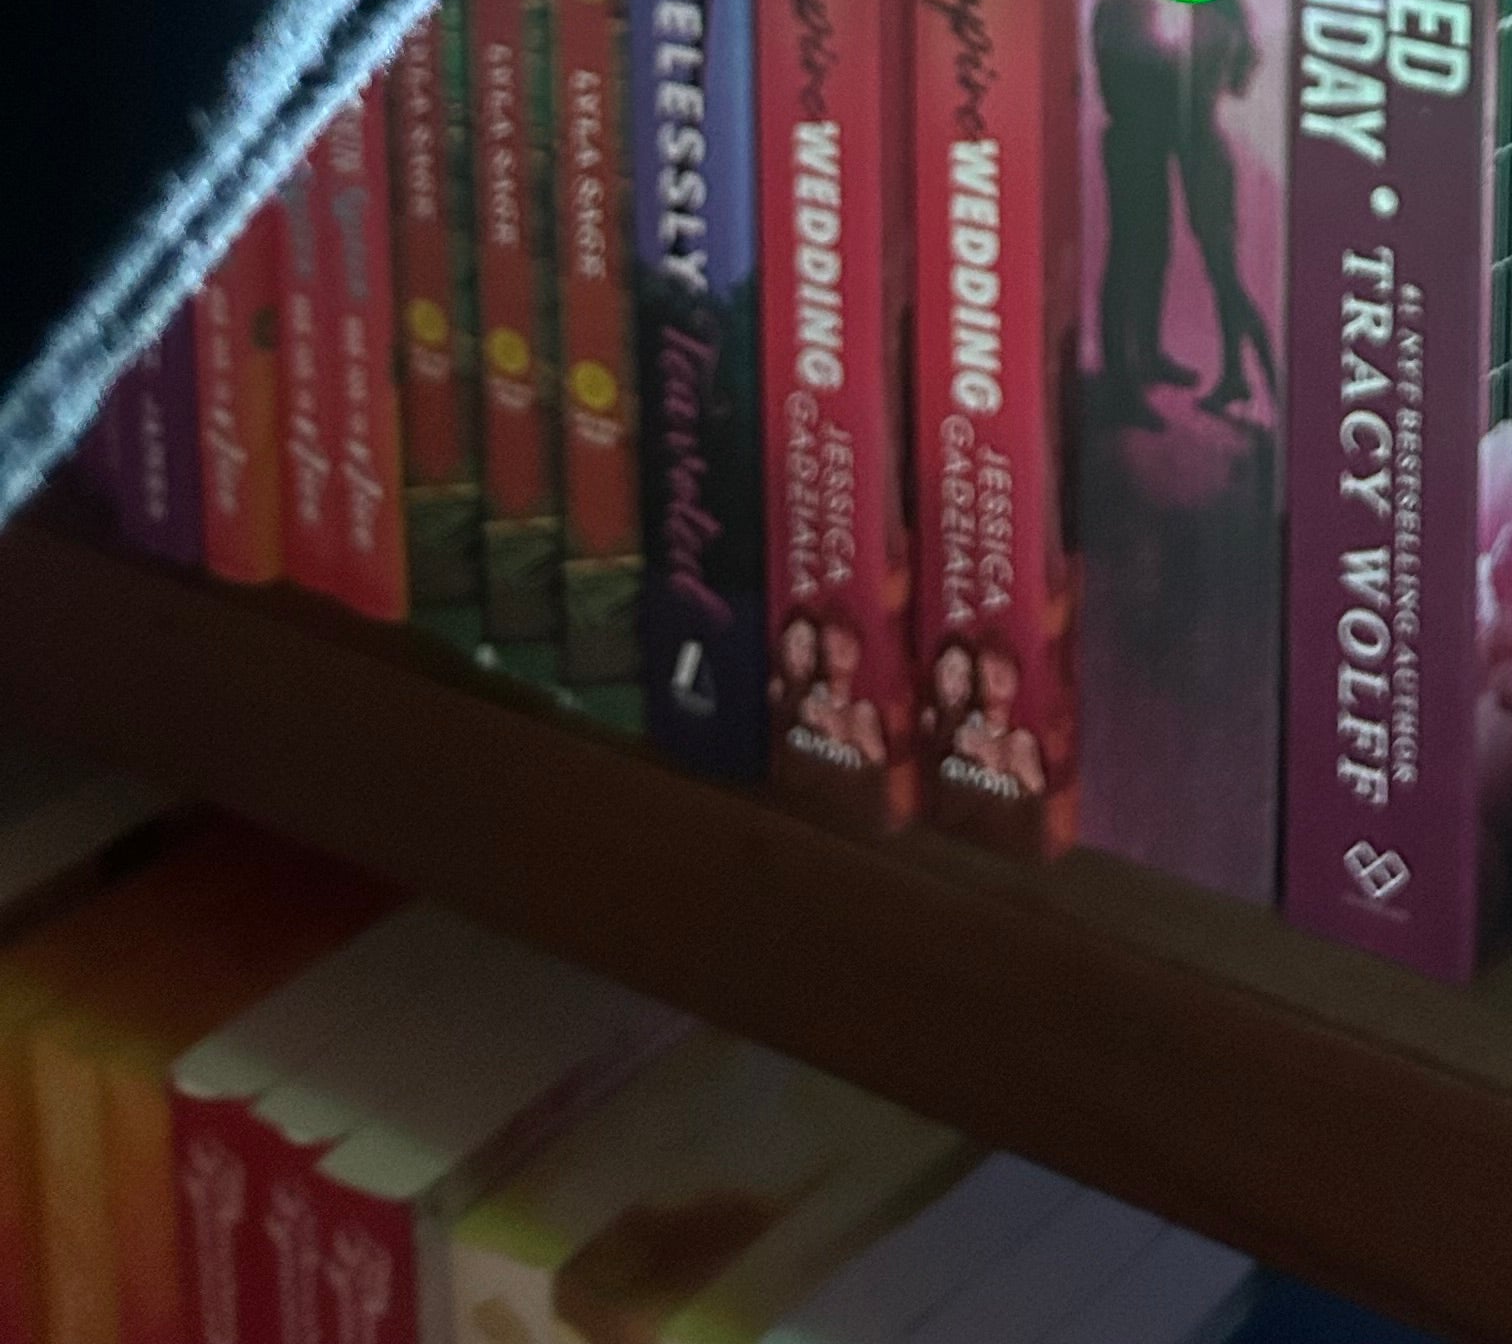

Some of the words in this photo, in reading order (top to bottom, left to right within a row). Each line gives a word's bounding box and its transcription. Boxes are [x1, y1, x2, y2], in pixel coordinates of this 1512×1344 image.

[792, 119, 842, 390] WEDDING
[948, 140, 1003, 414] WEDDING
[820, 422, 855, 585] JESSICA
[1339, 246, 1395, 516] TRACY
[977, 445, 1014, 610] JESSICA
[1394, 408, 1422, 638] BESTSELLING
[1336, 544, 1391, 806] WOLFF
[1391, 643, 1419, 785] AUTHOR
